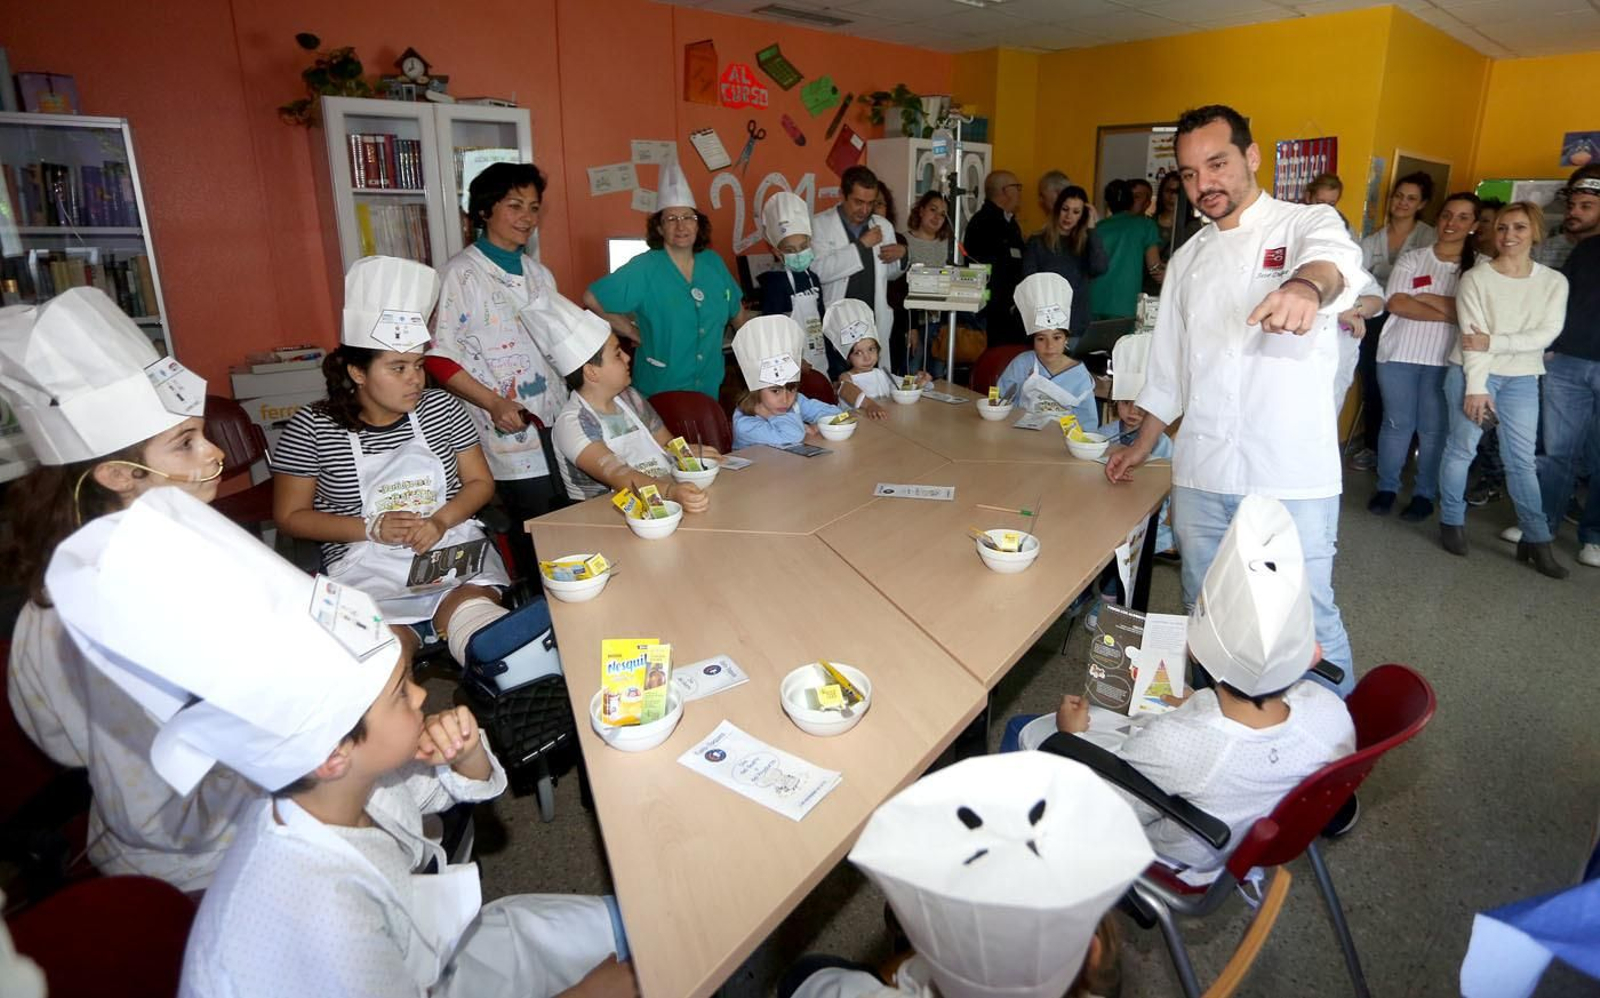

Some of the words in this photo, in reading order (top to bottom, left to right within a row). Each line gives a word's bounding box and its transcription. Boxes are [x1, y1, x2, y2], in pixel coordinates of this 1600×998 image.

[729, 65, 750, 84] AL
[721, 83, 769, 107] CURSO
[710, 172, 842, 254] 201
